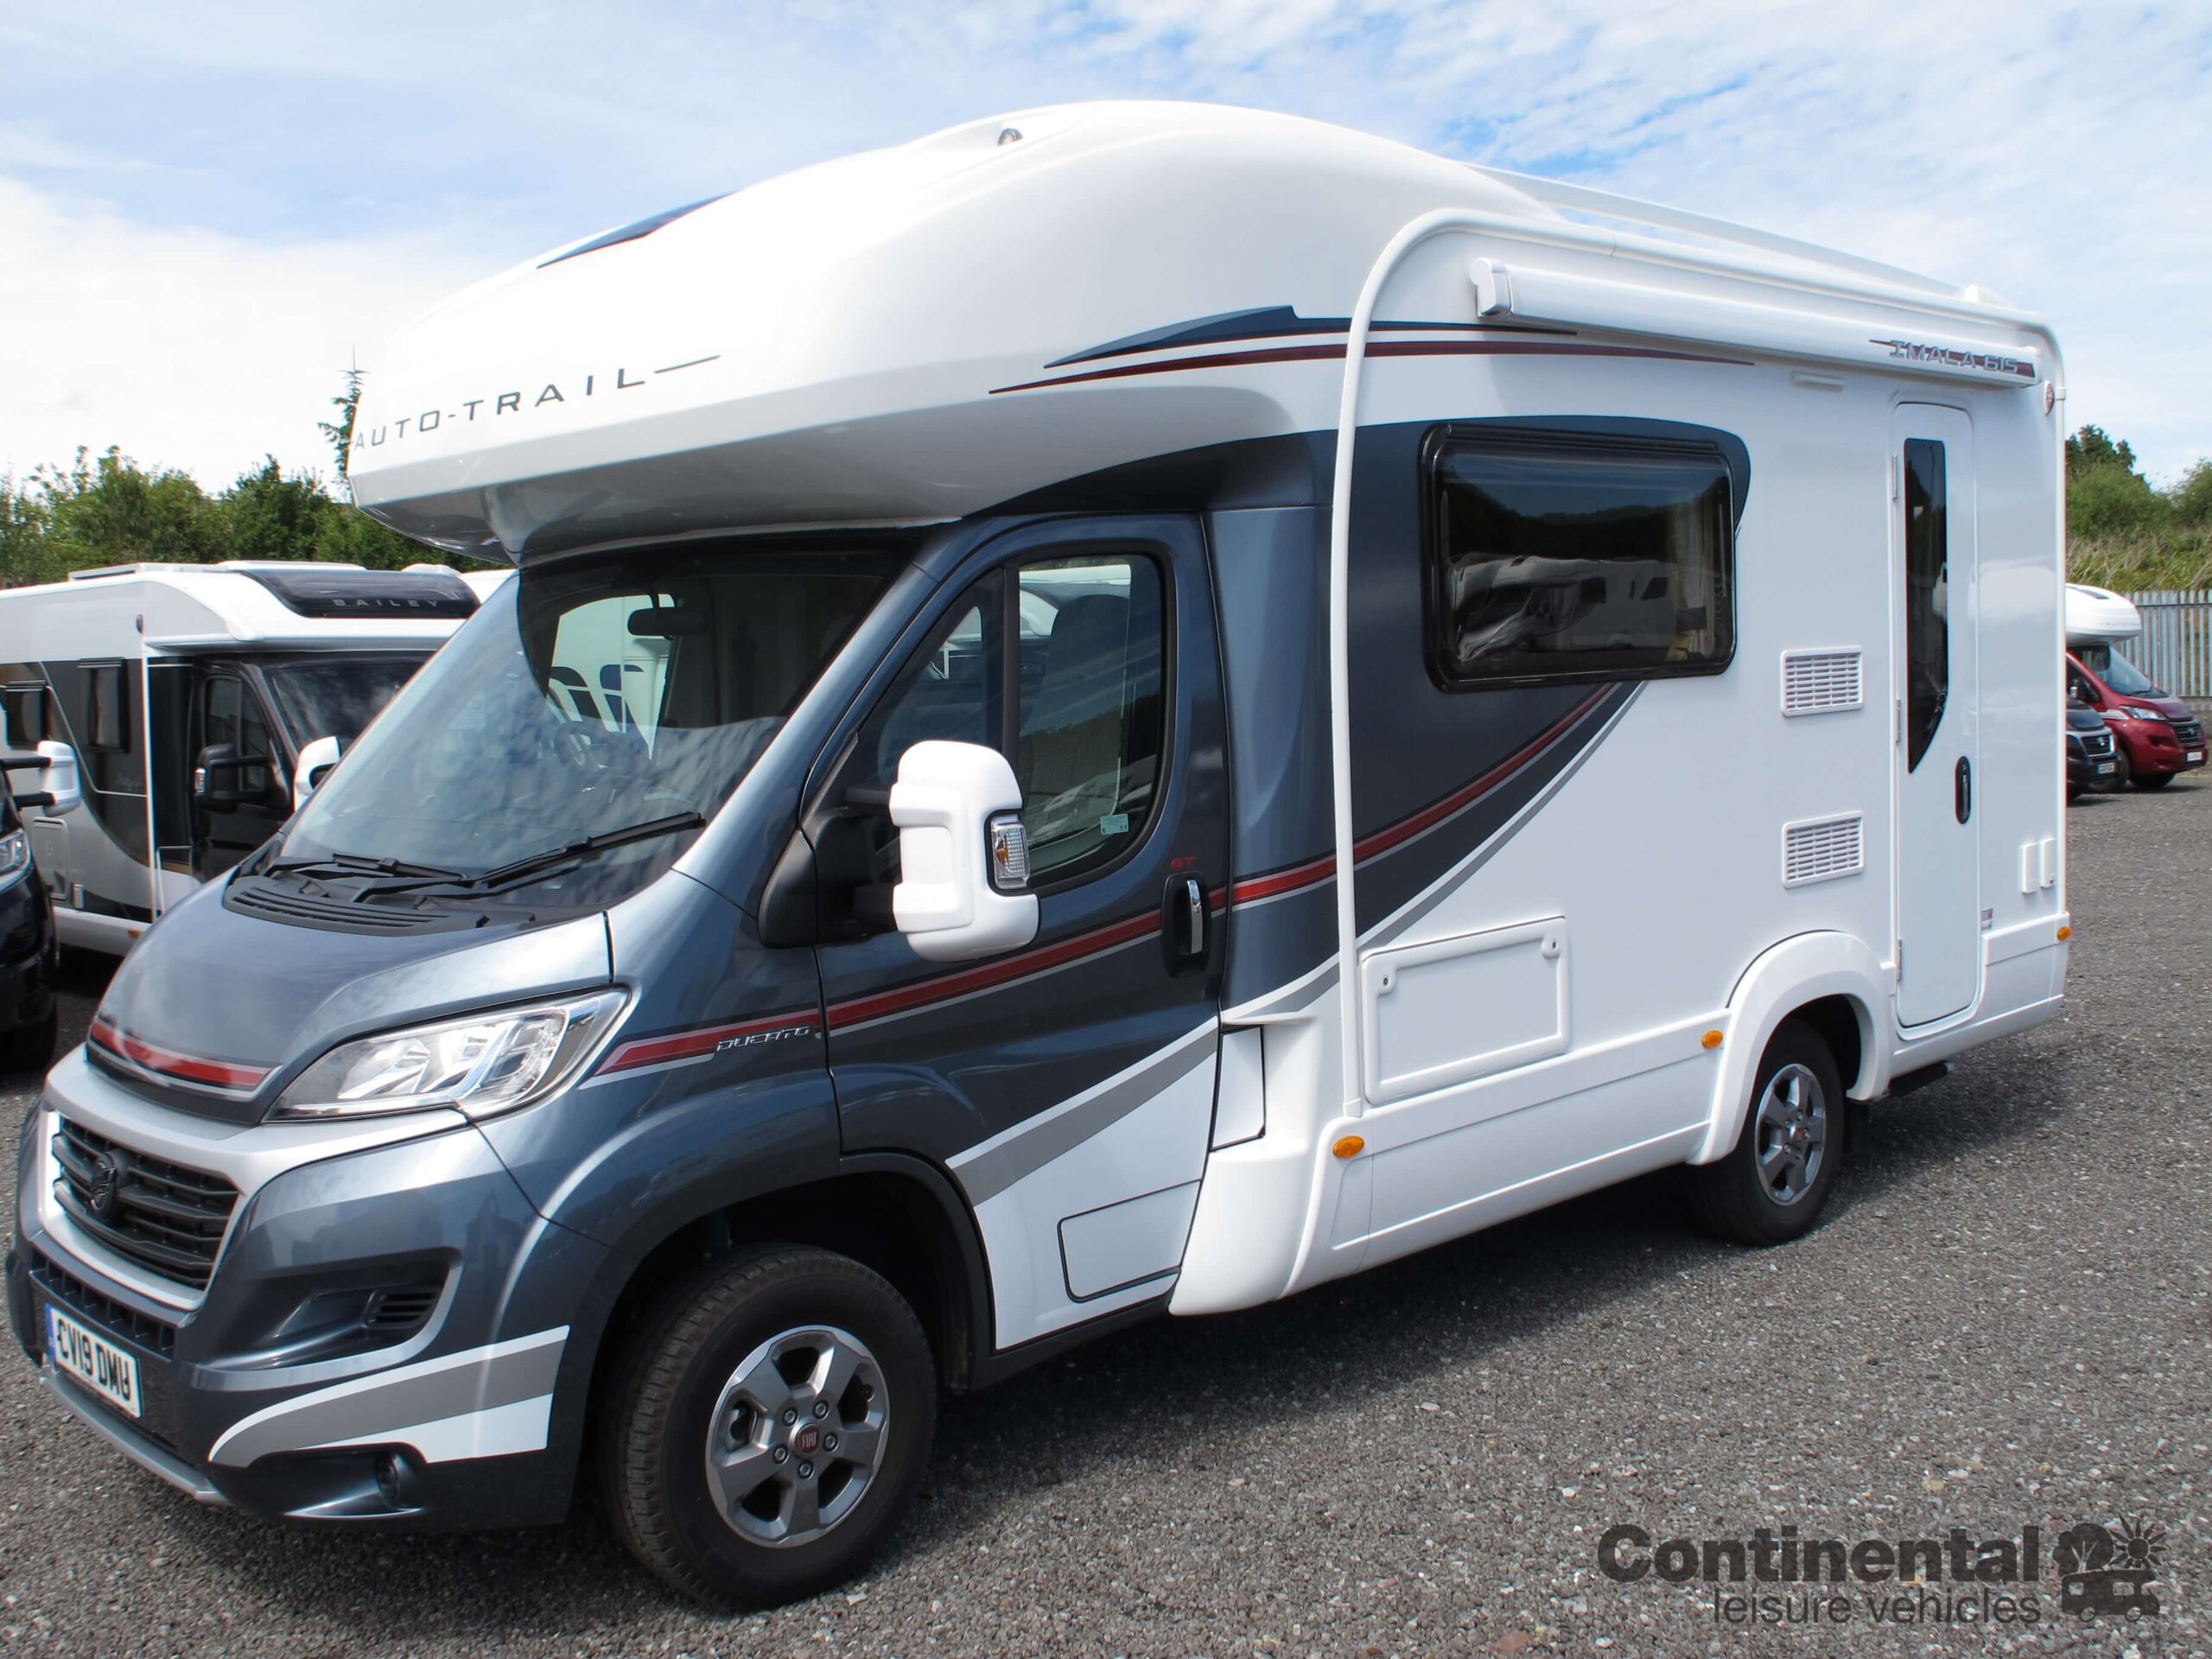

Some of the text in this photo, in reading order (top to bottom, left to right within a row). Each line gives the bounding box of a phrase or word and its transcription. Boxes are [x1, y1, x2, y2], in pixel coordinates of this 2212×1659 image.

[1889, 340, 1976, 369] IMALA
[354, 368, 645, 451] AUTO-TRAIL
[332, 598, 441, 607] BAILEY
[716, 1026, 811, 1052] DUCATO
[801, 1432, 817, 1449] FIAT
